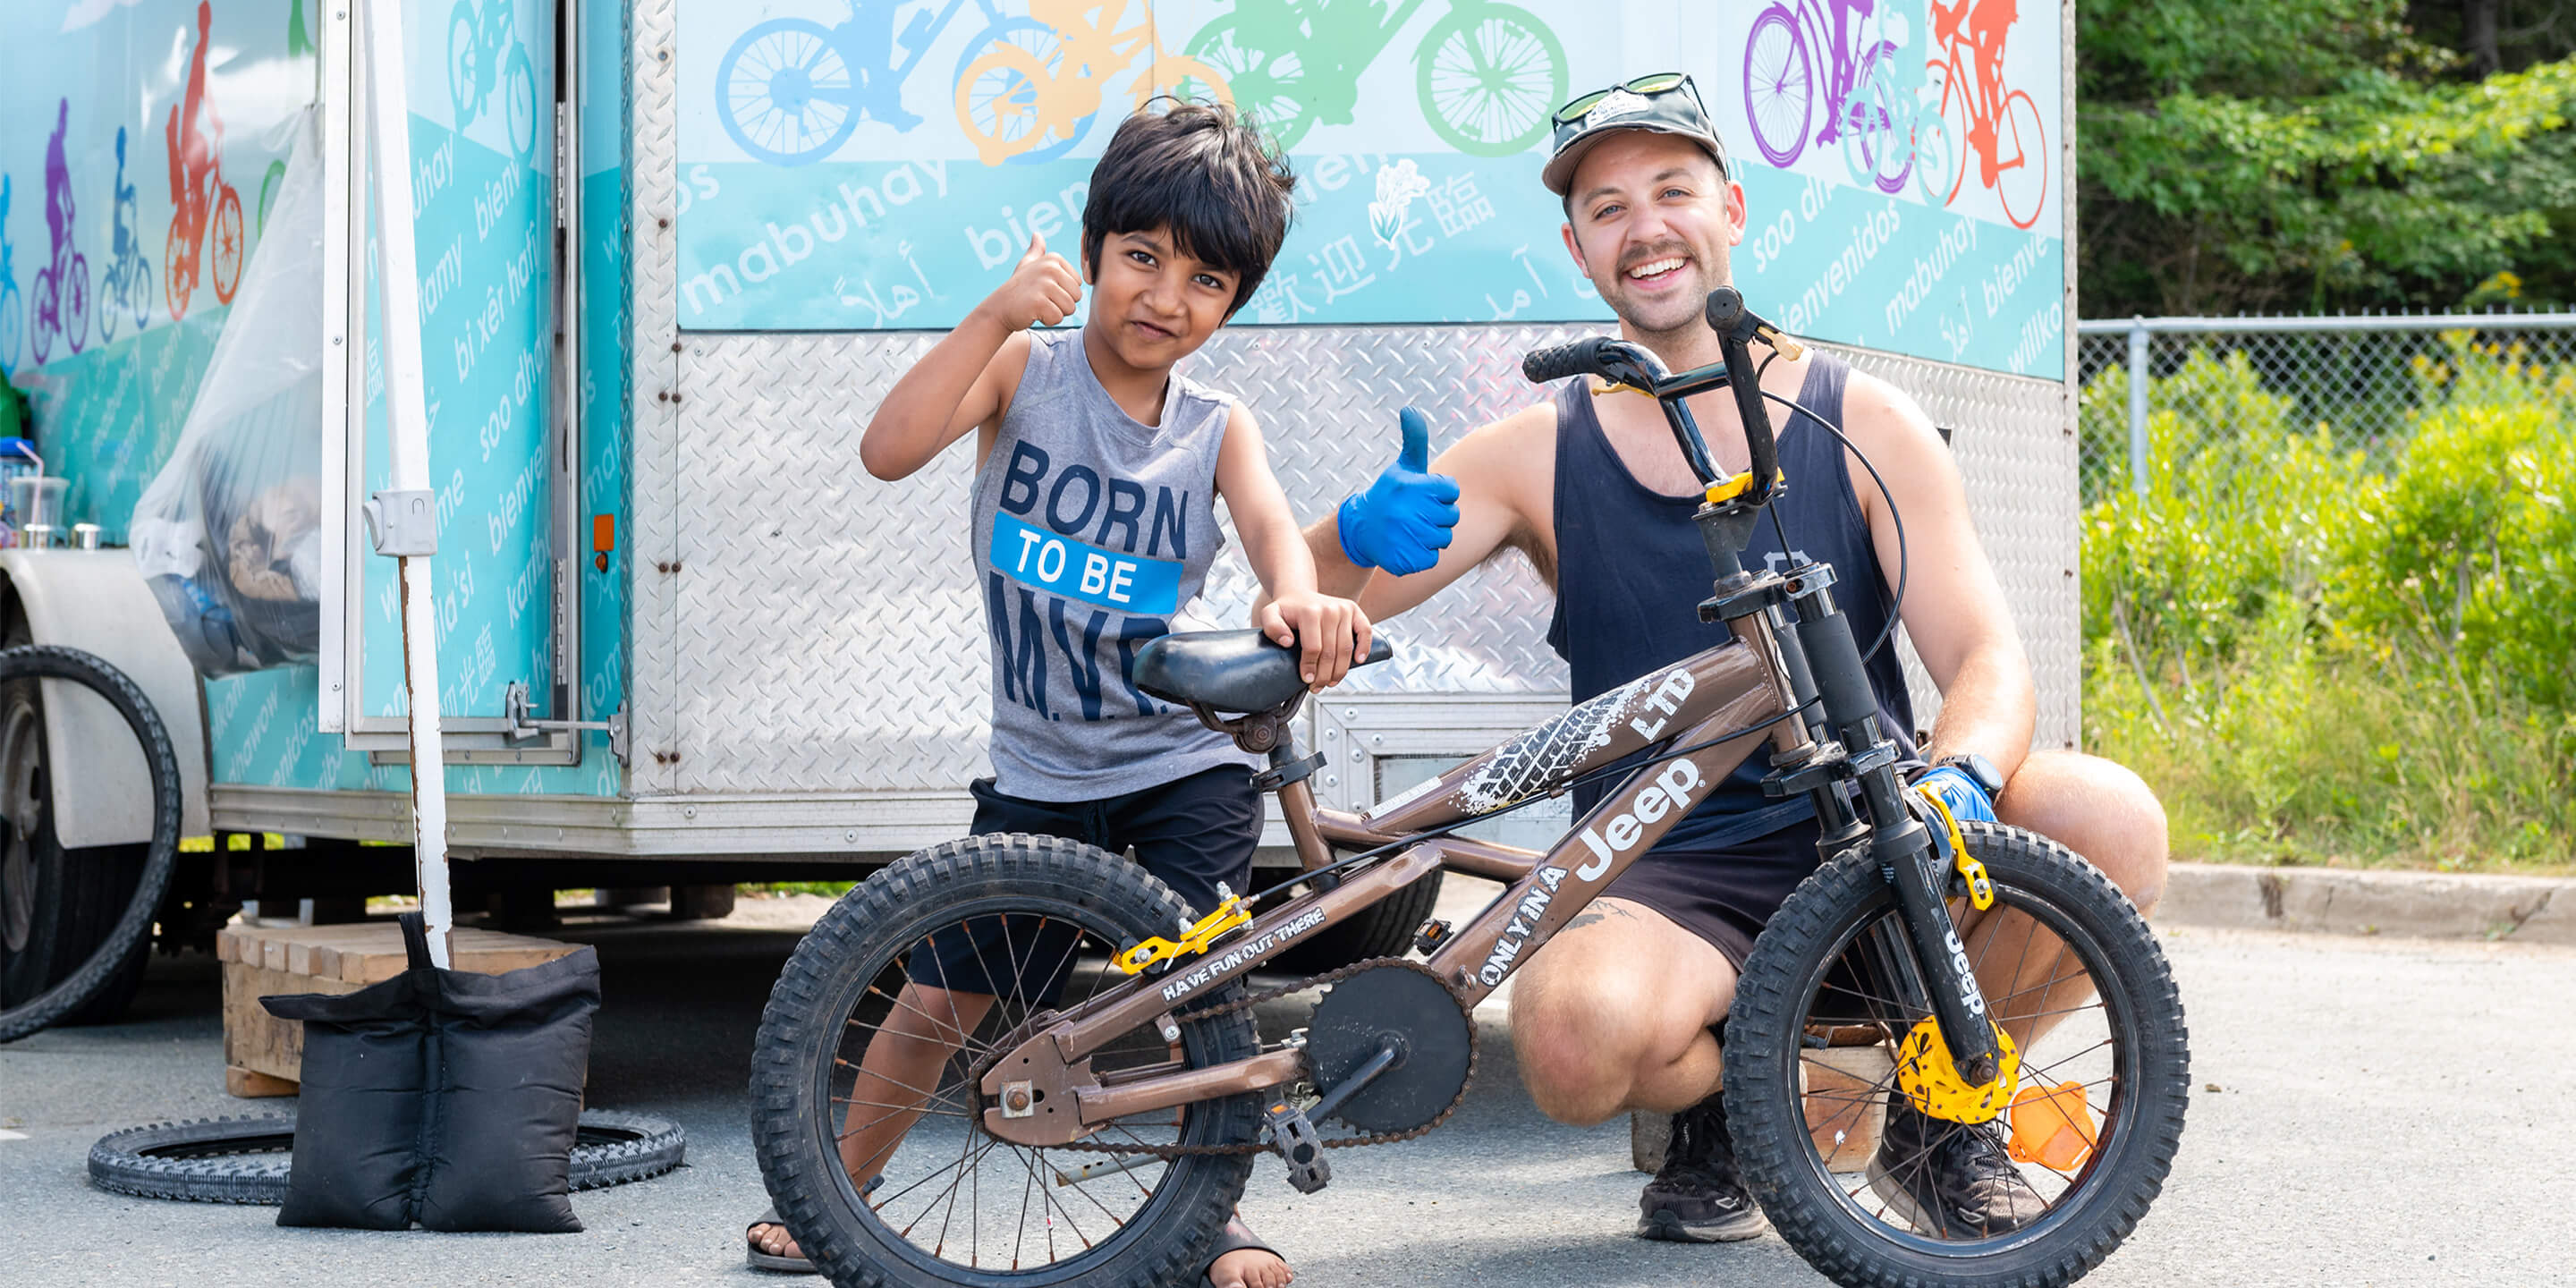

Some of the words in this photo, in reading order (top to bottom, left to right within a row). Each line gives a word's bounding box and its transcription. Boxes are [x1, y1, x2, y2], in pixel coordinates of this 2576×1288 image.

[682, 158, 948, 316] mabuhay
[1752, 208, 1796, 273] soo
[1885, 215, 1978, 336] mabuhay
[454, 318, 476, 385] bi
[480, 394, 511, 462] soo
[999, 438, 1189, 560] BORN
[1017, 529, 1066, 583] TO
[1079, 552, 1137, 604] BE
[1630, 668, 1695, 742] LTD
[1161, 967, 1210, 1003] HAVE
[1208, 948, 1244, 978] FUN
[1241, 933, 1275, 961] OUT
[1273, 905, 1326, 942] THERE
[1479, 912, 1532, 987] ONLY
[1517, 885, 1553, 922] IN
[1538, 866, 1569, 894] A
